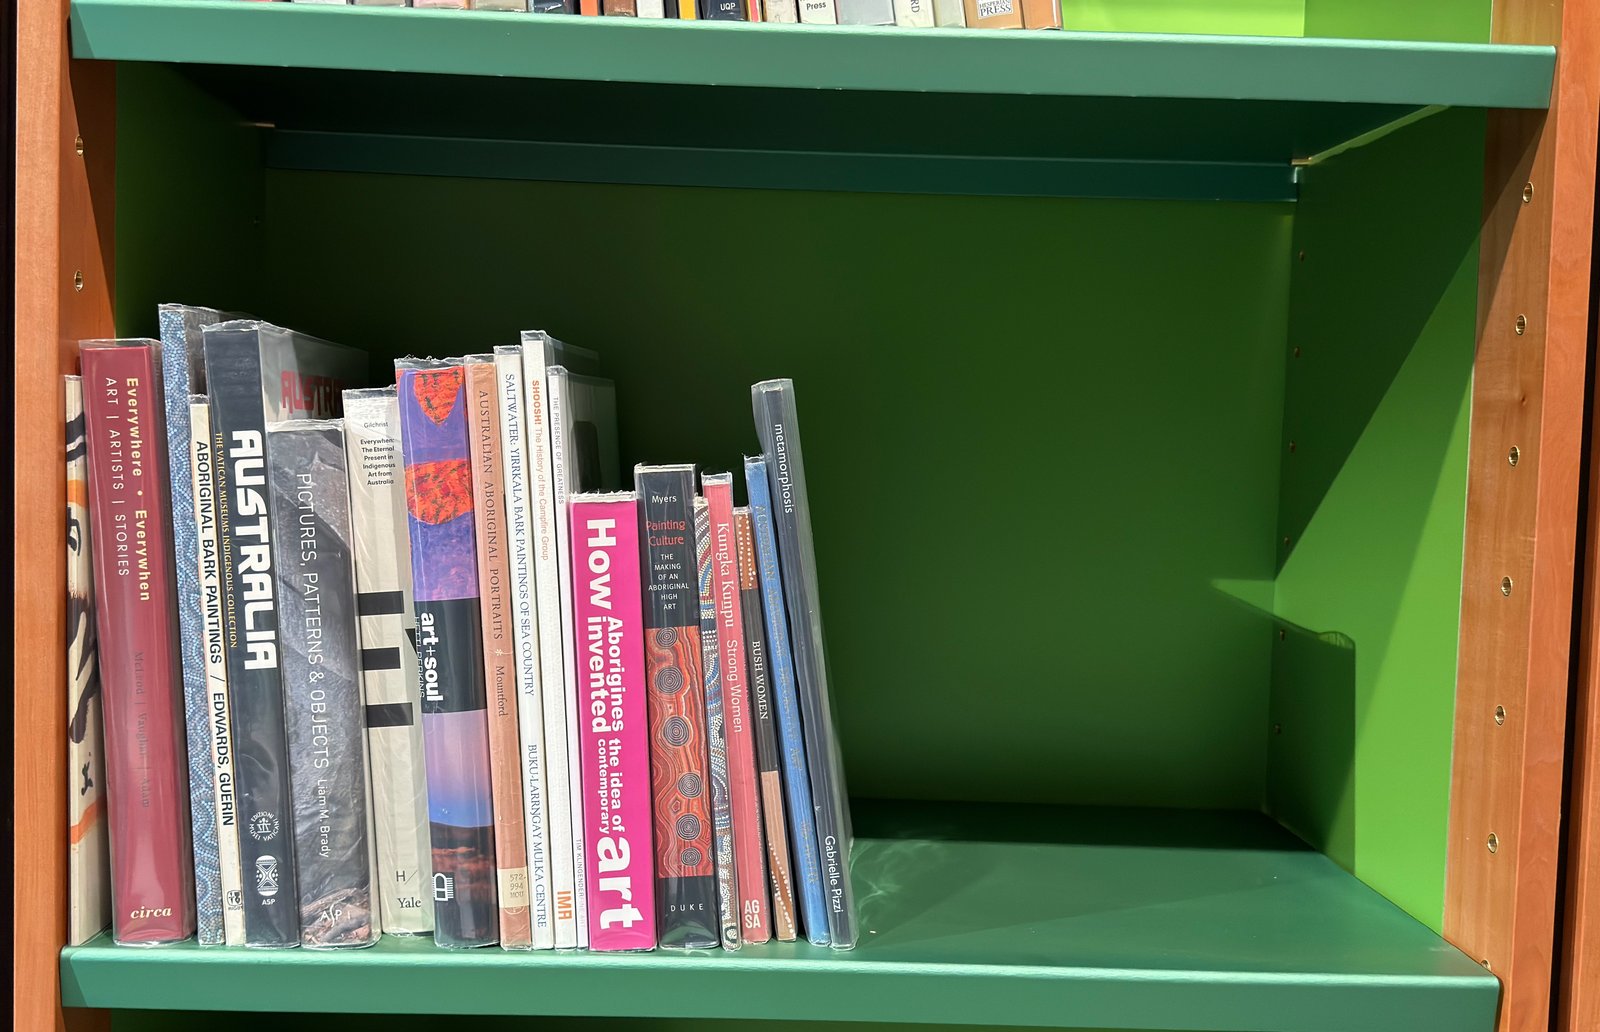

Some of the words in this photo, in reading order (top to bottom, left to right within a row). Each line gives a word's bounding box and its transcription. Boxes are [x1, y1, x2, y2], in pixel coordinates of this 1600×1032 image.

[720, 3, 736, 11] UQP
[806, 2, 827, 11] Press
[980, 5, 1011, 16] PRESS
[106, 378, 118, 404] ART
[505, 374, 518, 445] SALTWATER:
[532, 380, 542, 425] SHOOSH!
[215, 432, 223, 448] THE
[360, 438, 394, 446] Everywhen:
[480, 390, 492, 473] AUSTRALIAN
[535, 428, 543, 442] The
[553, 412, 562, 449] PRESENCE
[109, 430, 124, 489] ARTISTS
[217, 451, 226, 487] VATICAN
[536, 445, 544, 472] History
[555, 451, 562, 461] OF
[774, 423, 794, 514] metamorphosis
[127, 378, 143, 476] Everywhere
[135, 510, 151, 600] Everywhen
[196, 441, 213, 533] ABORIGINAL
[511, 448, 522, 503] YIRRKALA
[538, 475, 545, 483] of
[538, 484, 546, 497] the
[556, 463, 564, 504] GREATNESS
[220, 490, 229, 533] MUSEUMS
[539, 498, 548, 534] Campfire
[651, 495, 677, 504] Myers
[297, 473, 317, 566] PICTURES,
[484, 482, 498, 562] ABORIGINAL
[514, 506, 525, 536] BARK
[646, 520, 686, 531] Painting
[115, 514, 129, 575] STORIES
[203, 540, 216, 579] BARK
[229, 430, 278, 670] AUSTRALIA
[541, 536, 549, 560] Group
[648, 536, 684, 547] Culture
[716, 523, 733, 576] Kungka
[223, 536, 234, 592] INDIGENOUS
[516, 539, 528, 599] PAINTINGS
[586, 518, 616, 610] How
[654, 563, 681, 571] MAKING
[490, 568, 503, 640] PORTRAITS
[648, 583, 689, 591] ABORIGINAL
[206, 585, 222, 663] PAINTINGS
[227, 593, 237, 648] COLLECTION
[303, 572, 323, 664] PATTERNS
[520, 602, 529, 616] OF
[521, 618, 530, 639] SEA
[421, 612, 443, 701] art+soul
[522, 642, 534, 696] COUNTRY
[587, 616, 612, 733] invented
[606, 616, 626, 732] Aborigines
[727, 640, 738, 681] Strong
[752, 641, 763, 671] BUSH
[309, 671, 324, 683] &
[496, 666, 508, 716] Mountford
[730, 684, 743, 733] Women
[755, 673, 768, 720] WOMEN
[213, 693, 229, 769] EDWARDS,
[311, 690, 329, 769] OBJECTS
[608, 738, 622, 767] the
[219, 773, 234, 826] GUERIN
[318, 779, 328, 806] Liam
[597, 739, 609, 834] contemporary
[610, 773, 623, 809] idea
[320, 809, 329, 822] M.
[611, 814, 625, 832] of
[319, 826, 331, 858] Brady
[824, 836, 840, 885] Gabrielle
[533, 842, 544, 881] MULKA
[510, 882, 523, 891] 994
[596, 836, 644, 929] art
[831, 888, 844, 913] Pizzi
[130, 906, 172, 919] circa
[261, 898, 275, 906] ASP
[397, 897, 421, 909] Yale
[535, 884, 546, 928] CENTRE
[557, 890, 572, 920] IMA
[670, 903, 704, 912] DUKE
[744, 899, 760, 914] AG
[745, 914, 761, 929] SA
